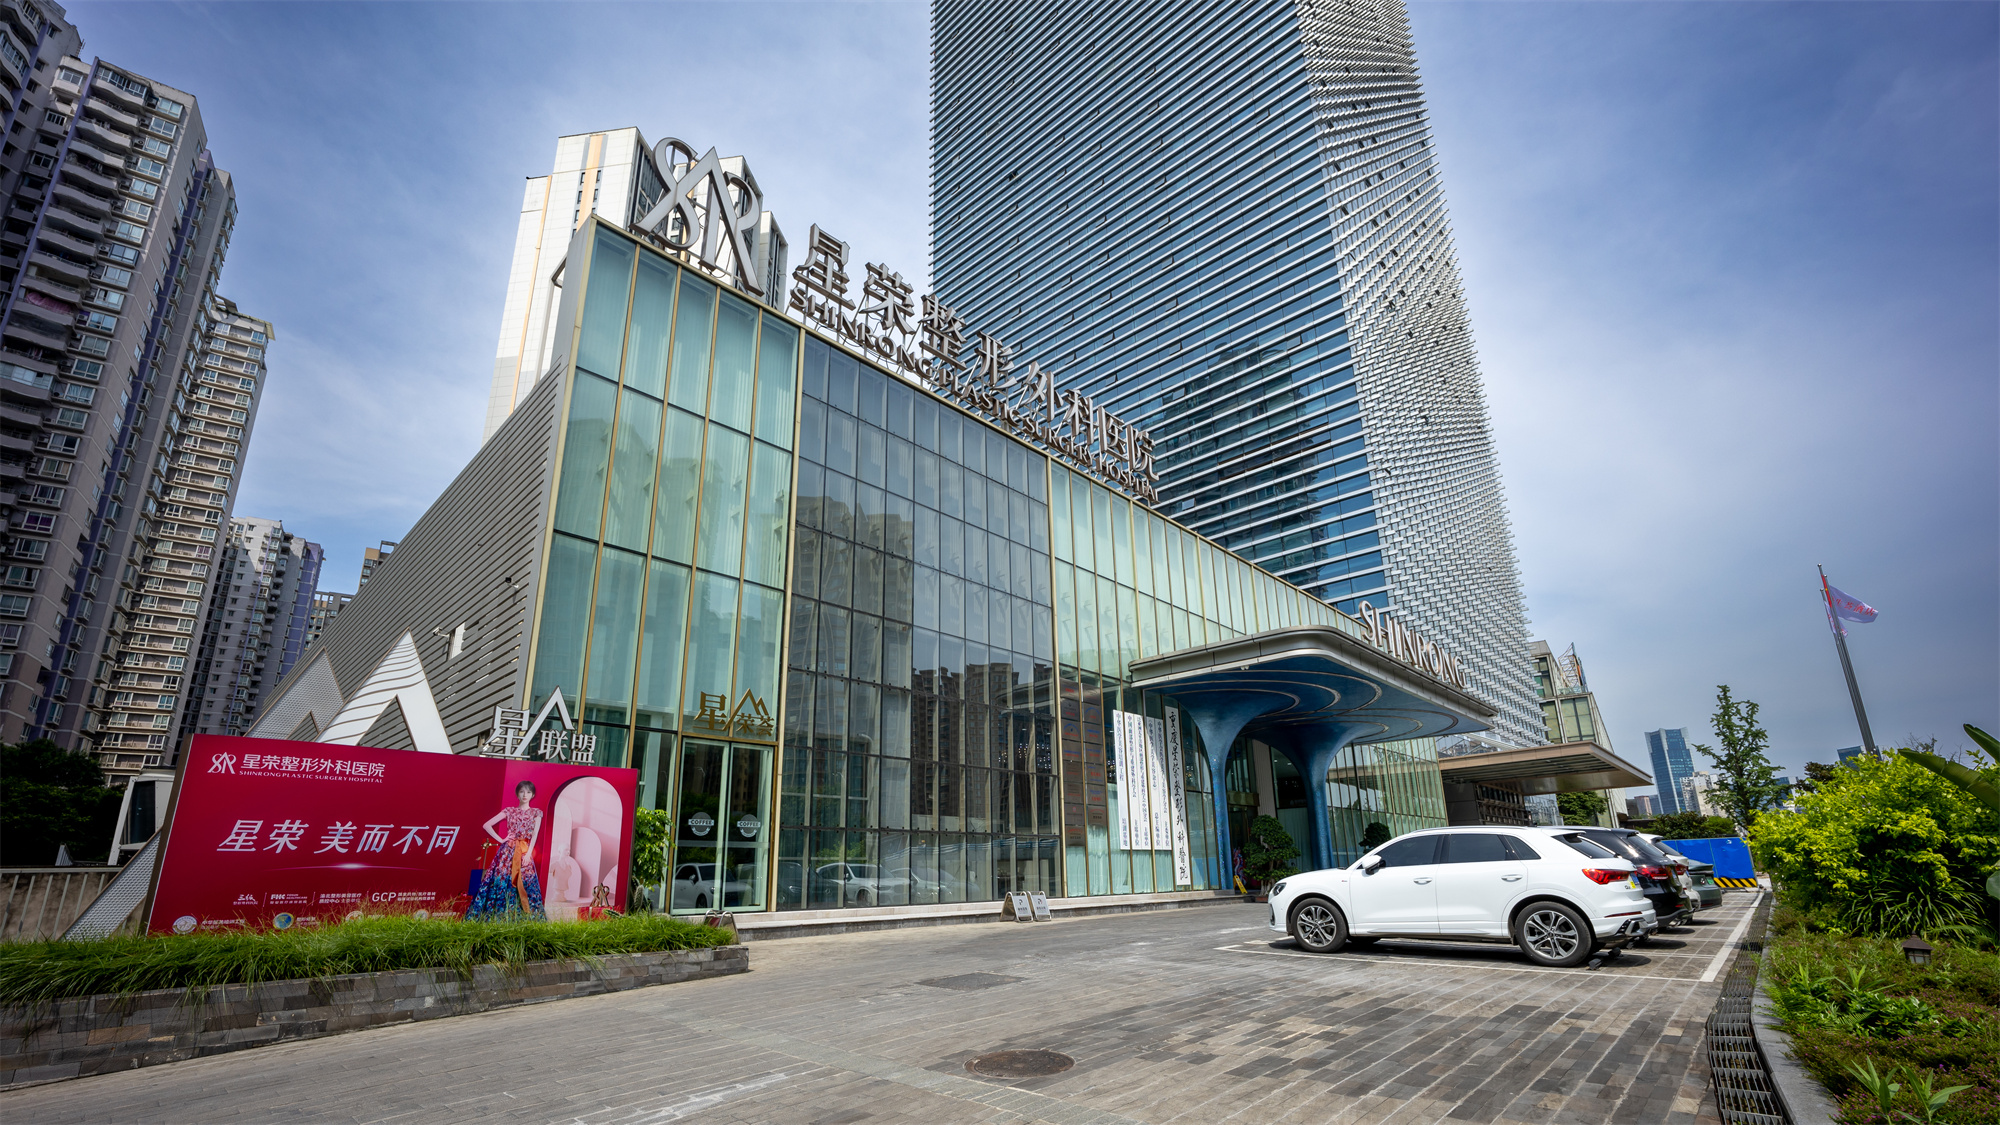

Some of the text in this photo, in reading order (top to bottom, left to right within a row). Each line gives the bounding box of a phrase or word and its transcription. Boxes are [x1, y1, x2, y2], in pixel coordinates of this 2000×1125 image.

[792, 223, 1159, 480] 星荣整形外科医院
[790, 287, 932, 378] SHINRONG
[939, 368, 1020, 427] PLASTIC
[1022, 417, 1095, 467] SURGERY
[1359, 600, 1466, 688] SHINRONG
[239, 770, 281, 778] SHINRONG
[241, 753, 385, 778] 星荣整形外科医院
[217, 819, 460, 855] 星荣 美而不同
[690, 818, 713, 826] COFFEE
[372, 892, 396, 902] GCP
